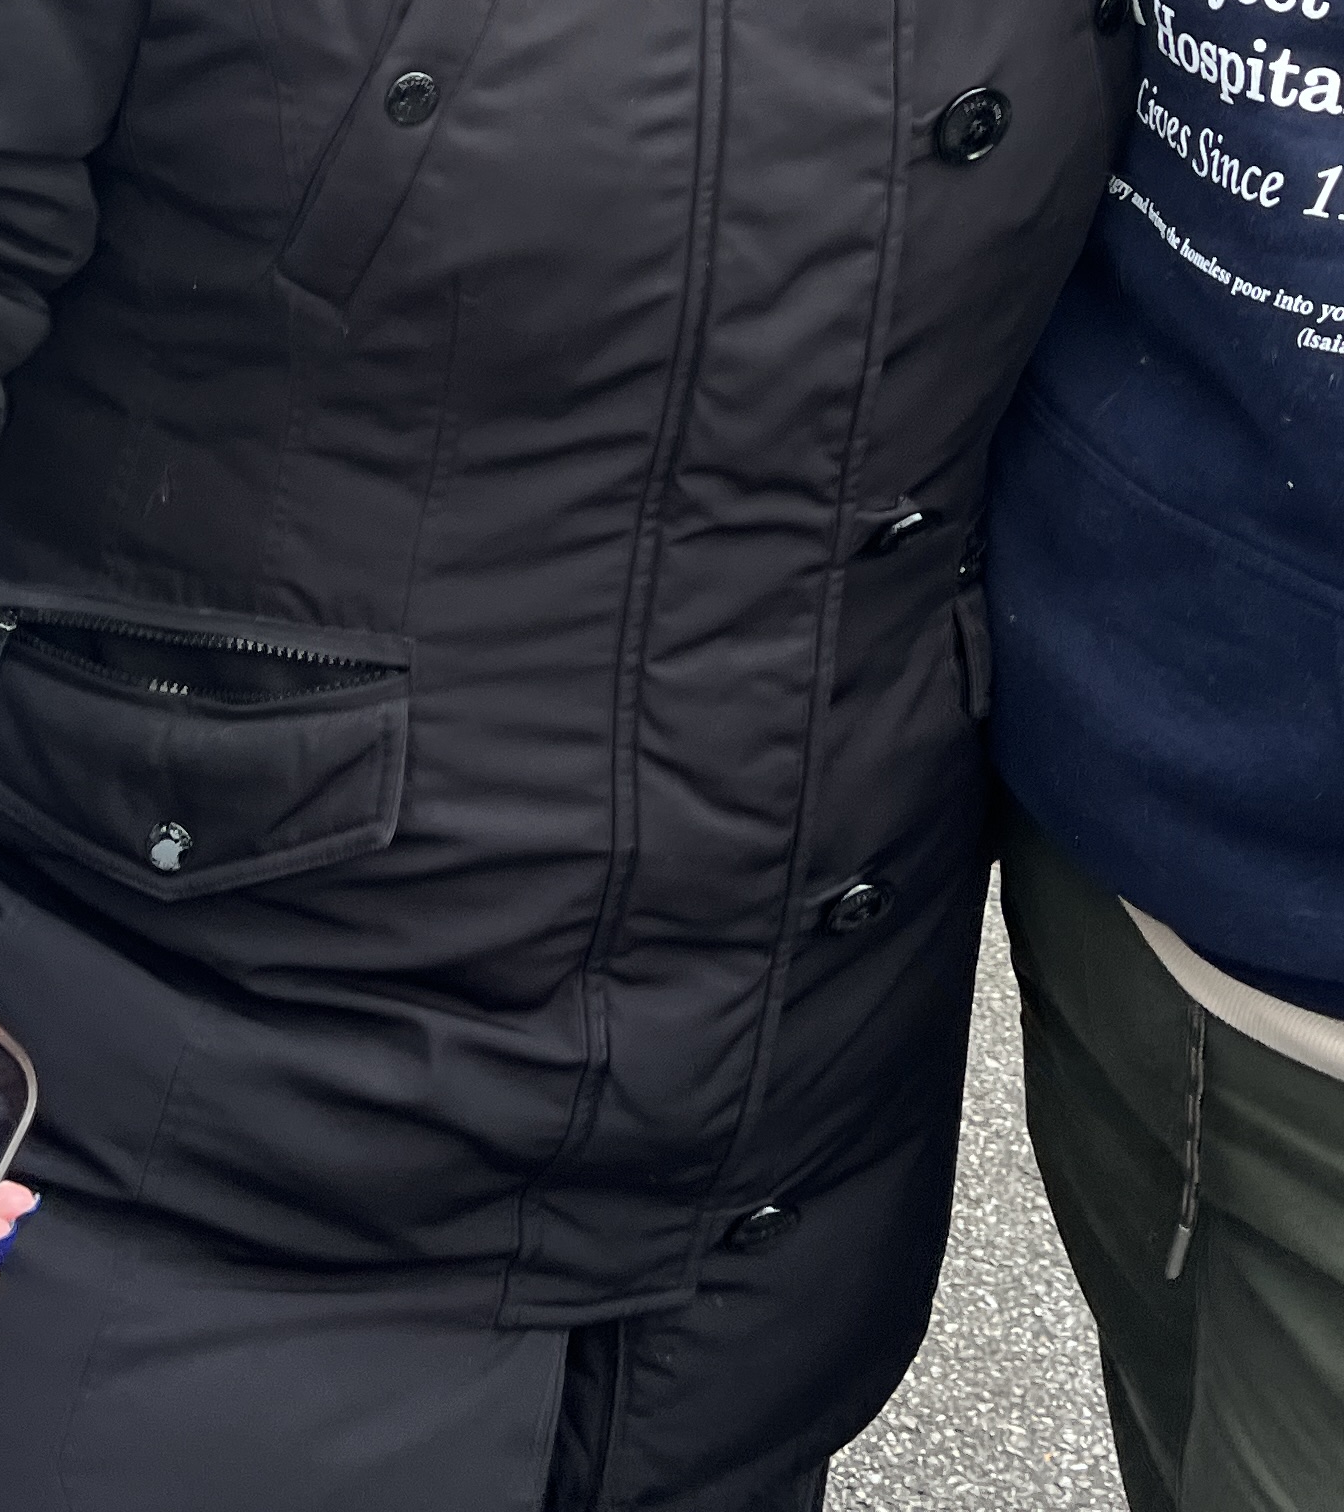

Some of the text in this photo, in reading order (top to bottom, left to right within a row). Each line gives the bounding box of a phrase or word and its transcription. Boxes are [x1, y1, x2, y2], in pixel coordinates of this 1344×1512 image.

[1136, 77, 1192, 159] Lives
[1192, 128, 1285, 208] Since
[1131, 192, 1150, 214] and
[1148, 202, 1167, 239] bring
[1166, 227, 1181, 249] the
[1180, 238, 1232, 285] homeless
[1230, 277, 1271, 303] poor
[1273, 289, 1314, 315] into
